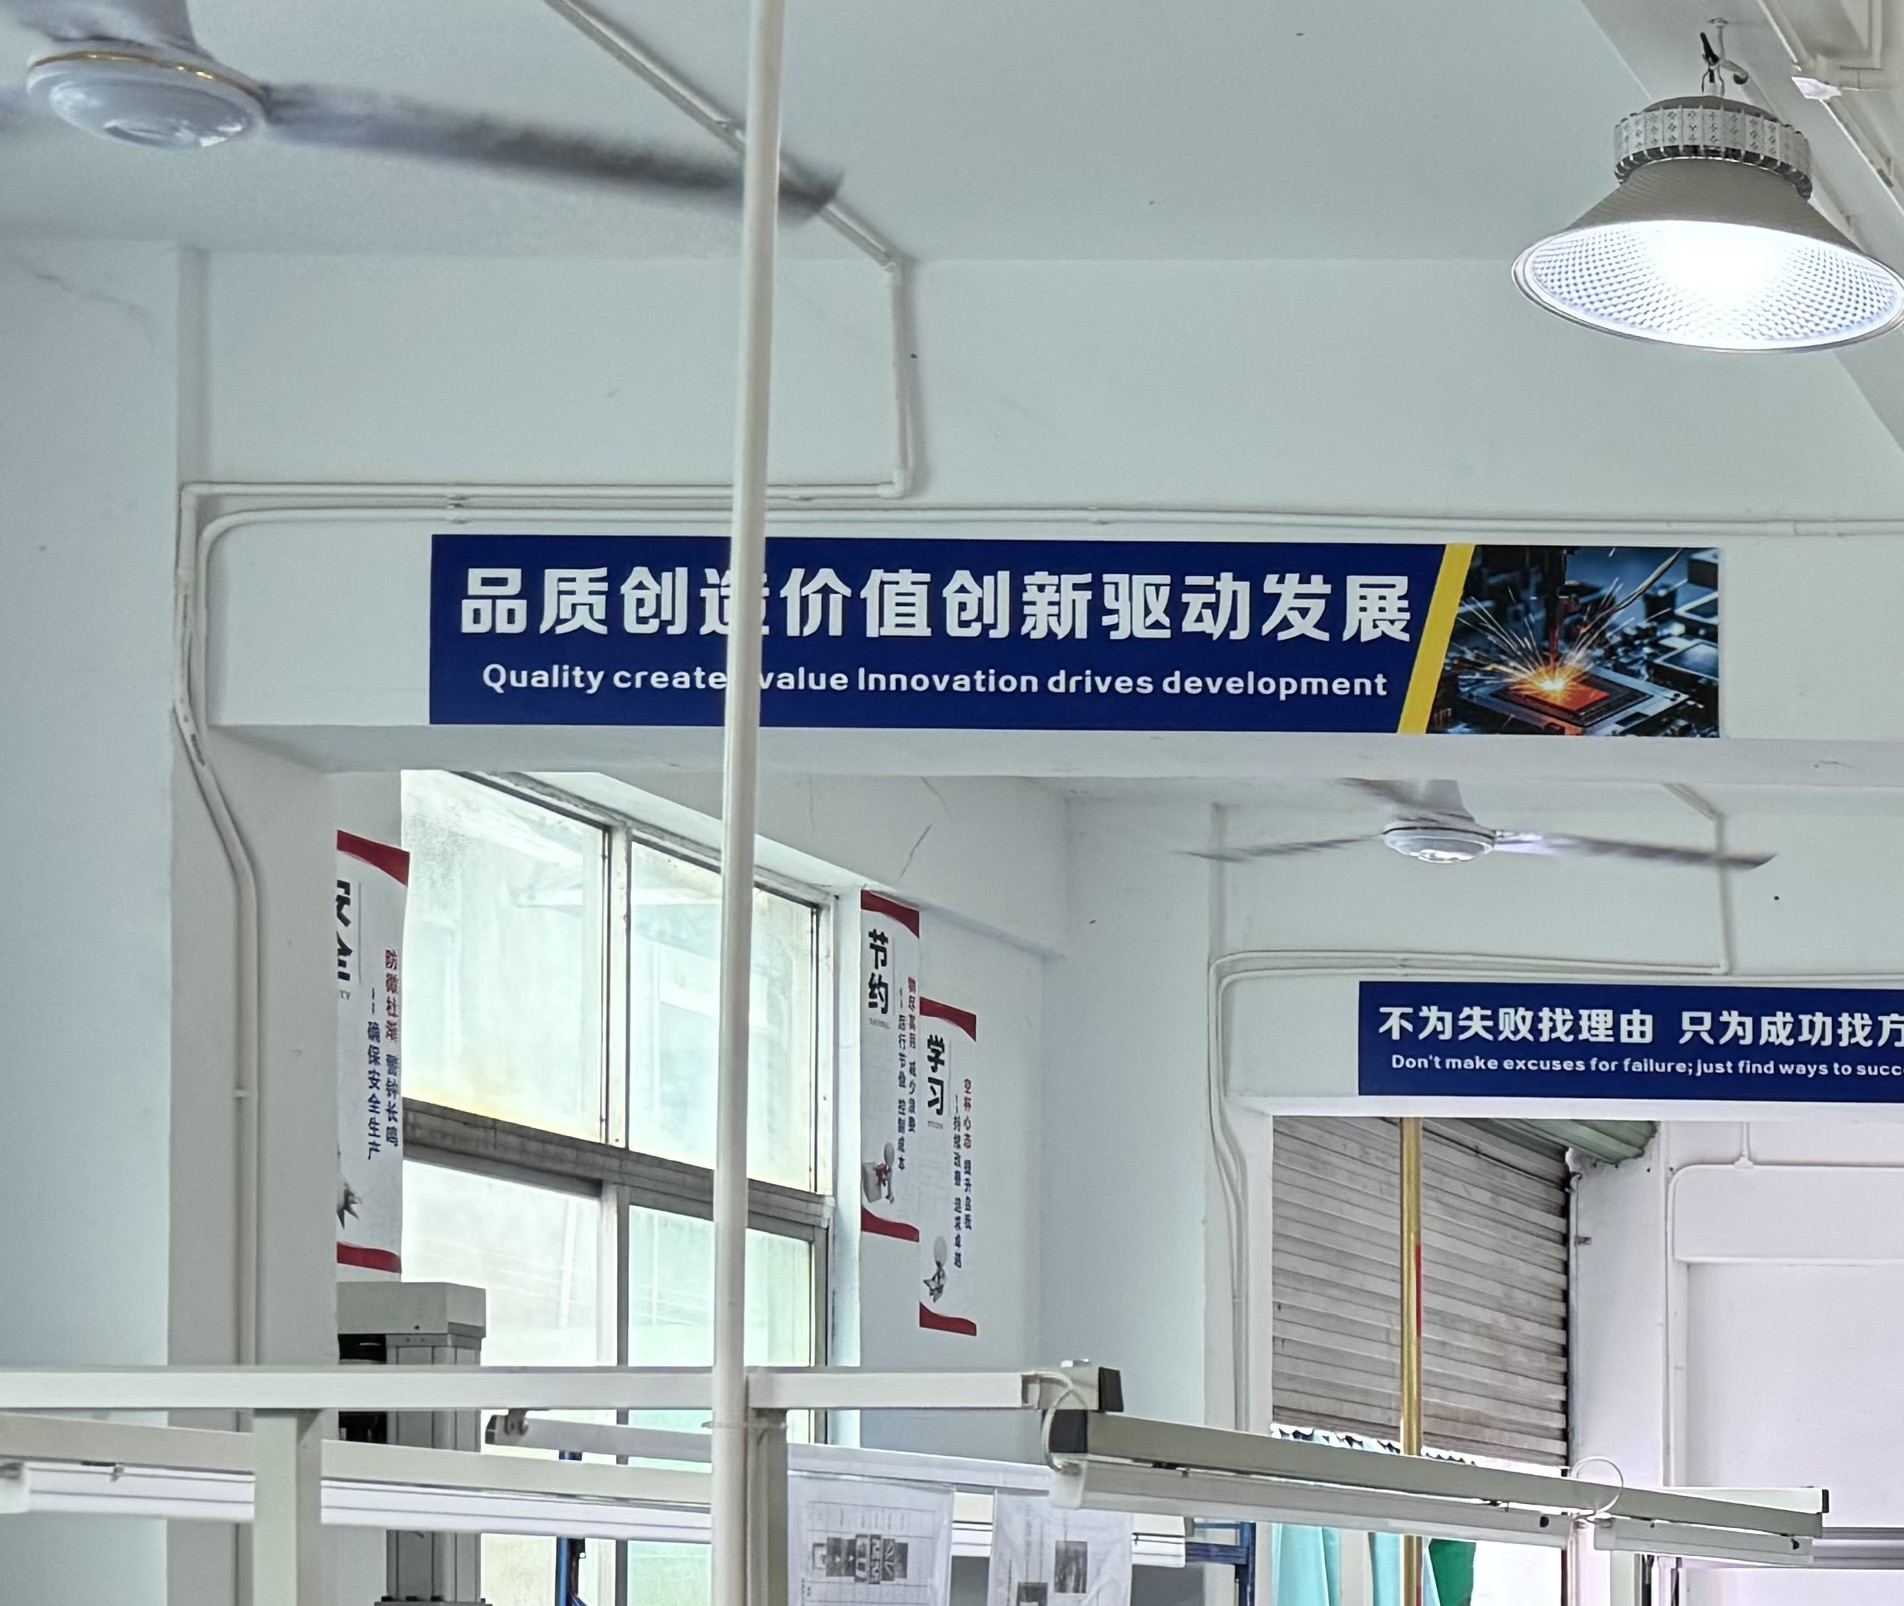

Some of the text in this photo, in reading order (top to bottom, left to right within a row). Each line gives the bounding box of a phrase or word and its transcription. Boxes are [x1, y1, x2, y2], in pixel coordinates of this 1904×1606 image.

[483, 663, 1387, 700] Quality create value Innovation drives development
[868, 928, 889, 1015] 节约
[1378, 1006, 1653, 1044] 不为失败找理由
[927, 1034, 945, 1116] 学习
[1391, 1054, 1441, 1070] Don't
[1446, 1055, 1499, 1070] make
[1503, 1059, 1586, 1072] excuses
[1590, 1057, 1619, 1072] for
[1623, 1057, 1694, 1075] failure;
[1697, 1060, 1734, 1076] just
[1738, 1060, 1775, 1075] find
[1779, 1063, 1829, 1078] ways
[1833, 1062, 1853, 1076] to
